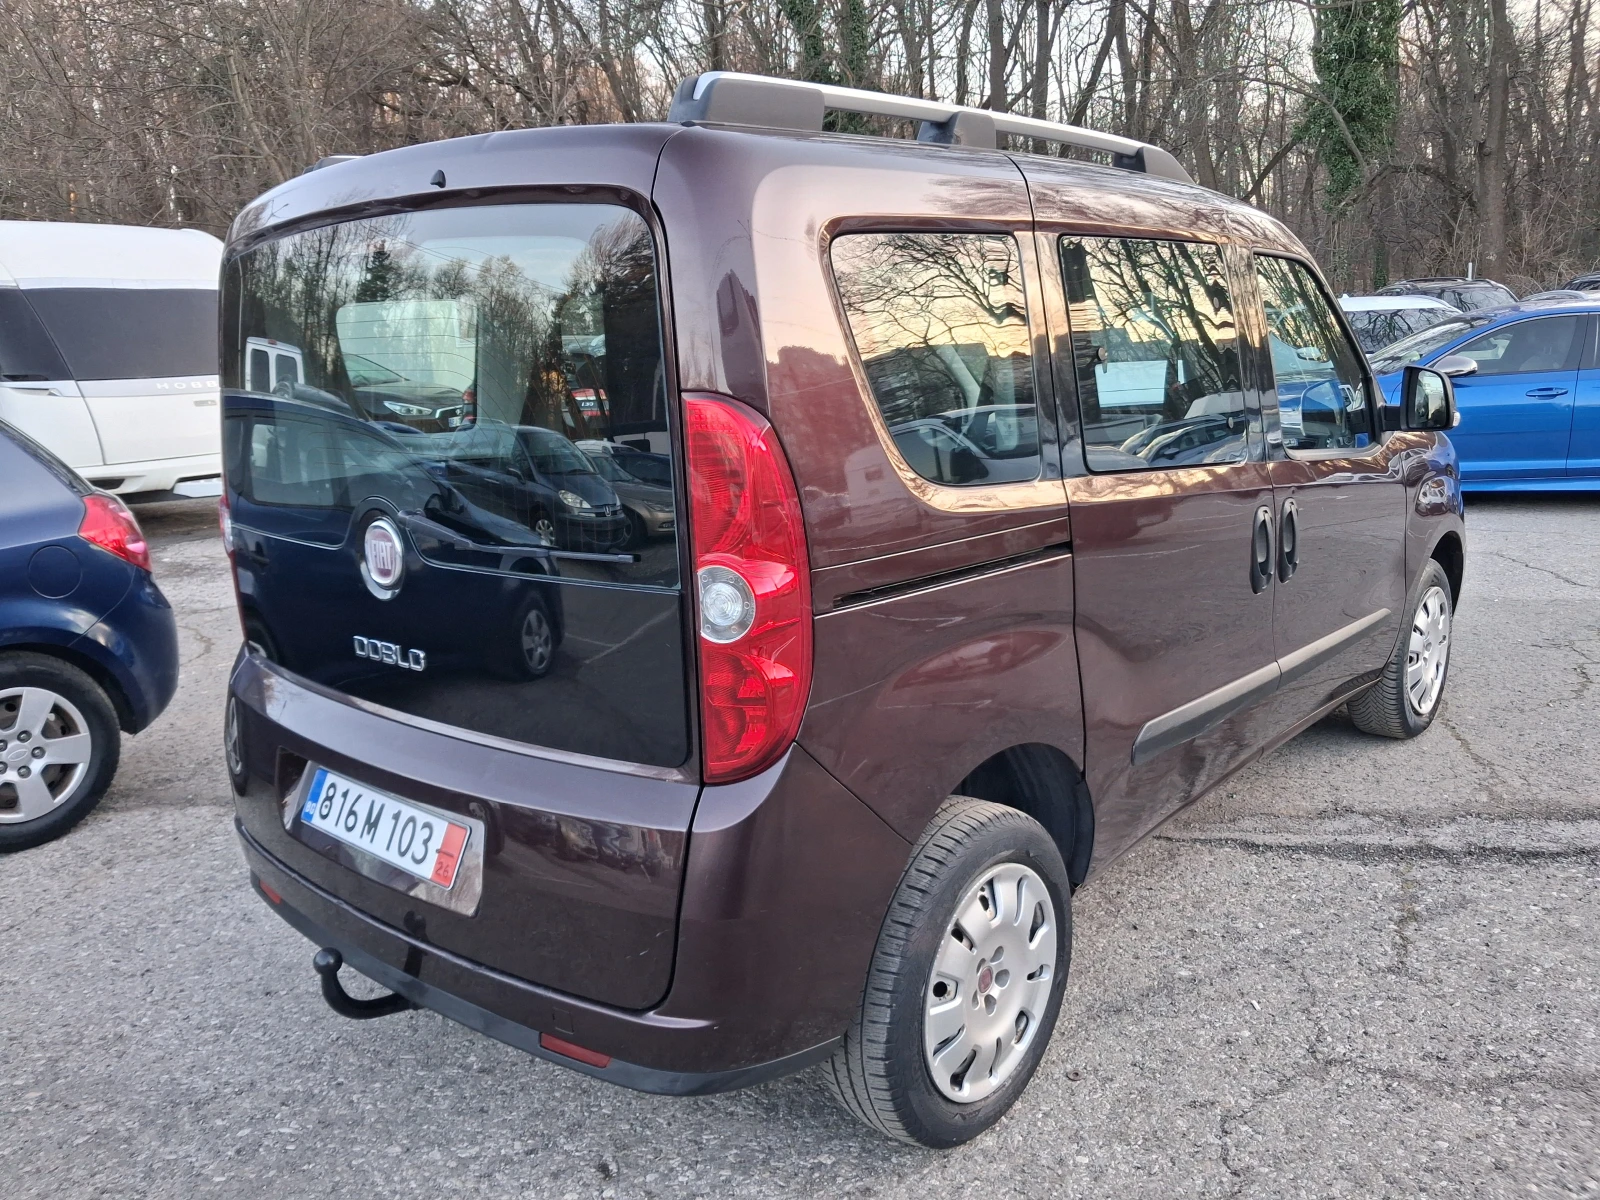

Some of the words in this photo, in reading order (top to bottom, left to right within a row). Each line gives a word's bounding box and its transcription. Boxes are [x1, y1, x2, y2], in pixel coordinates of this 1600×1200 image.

[370, 539, 393, 570] FIAT
[353, 635, 427, 671] DOBLO
[435, 861, 449, 878] 26
